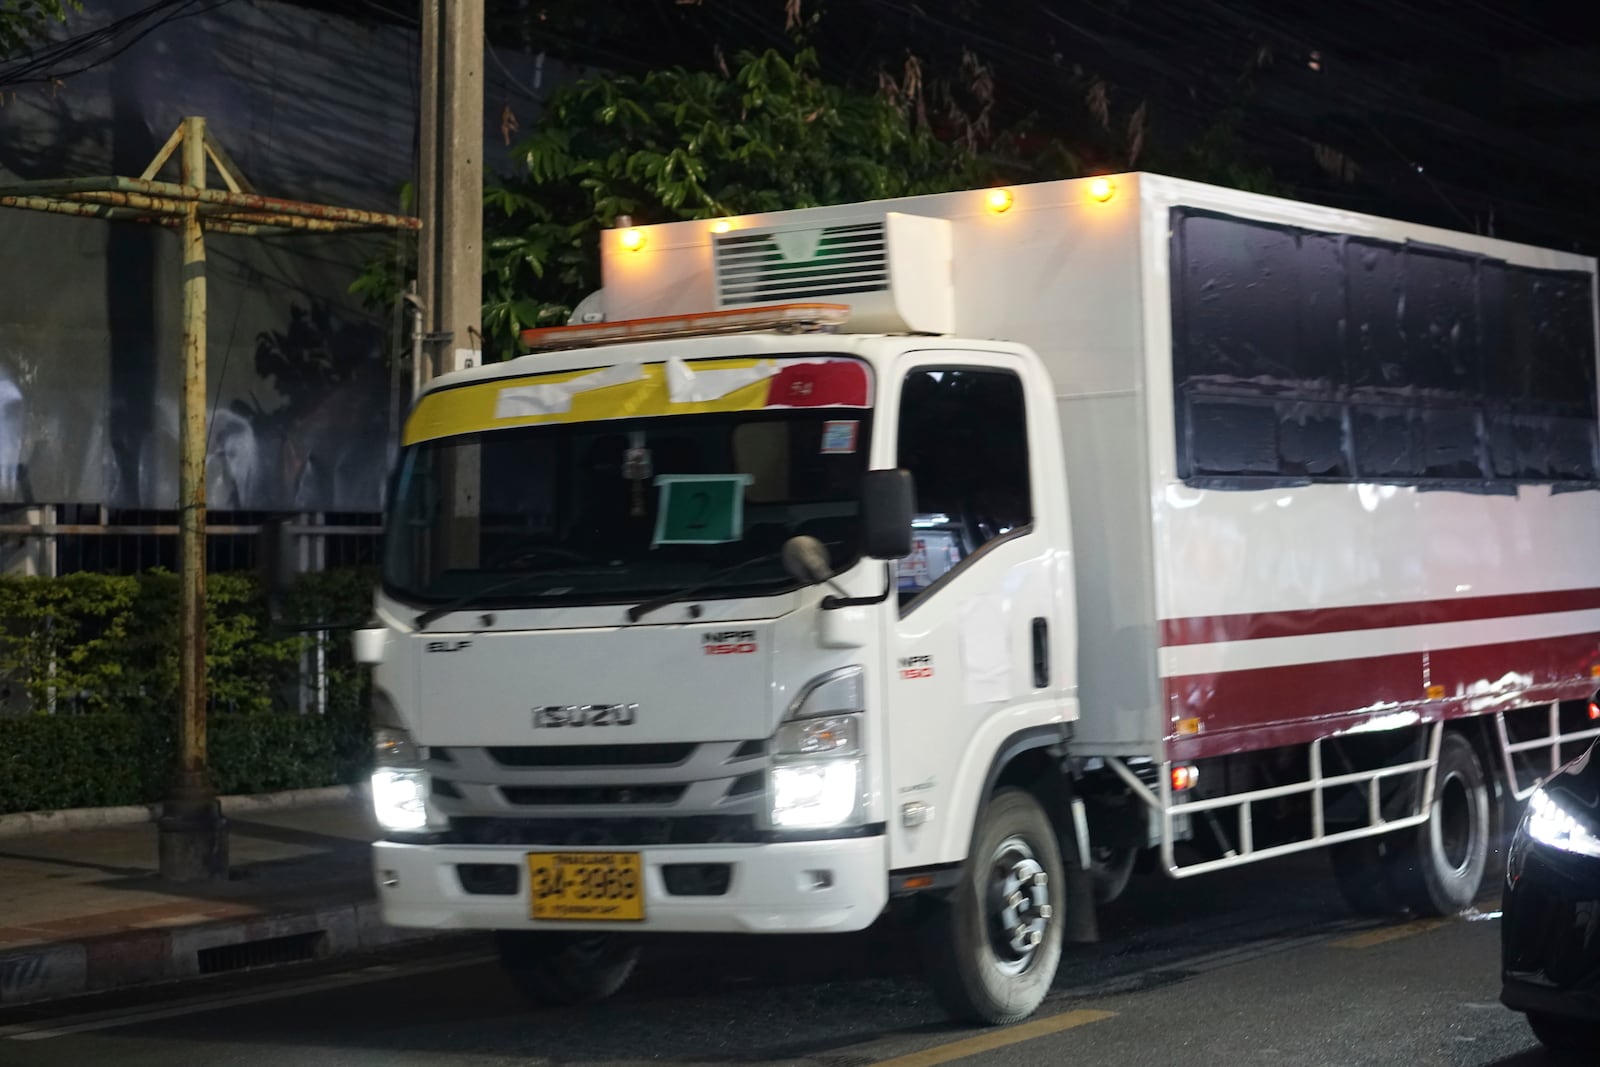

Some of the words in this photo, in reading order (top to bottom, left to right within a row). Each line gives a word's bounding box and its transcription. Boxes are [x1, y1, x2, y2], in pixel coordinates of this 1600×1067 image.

[687, 491, 710, 529] 2
[702, 630, 755, 643] NPR
[427, 641, 472, 652] ELF
[704, 643, 756, 655] 150
[533, 703, 638, 728] ISUZU
